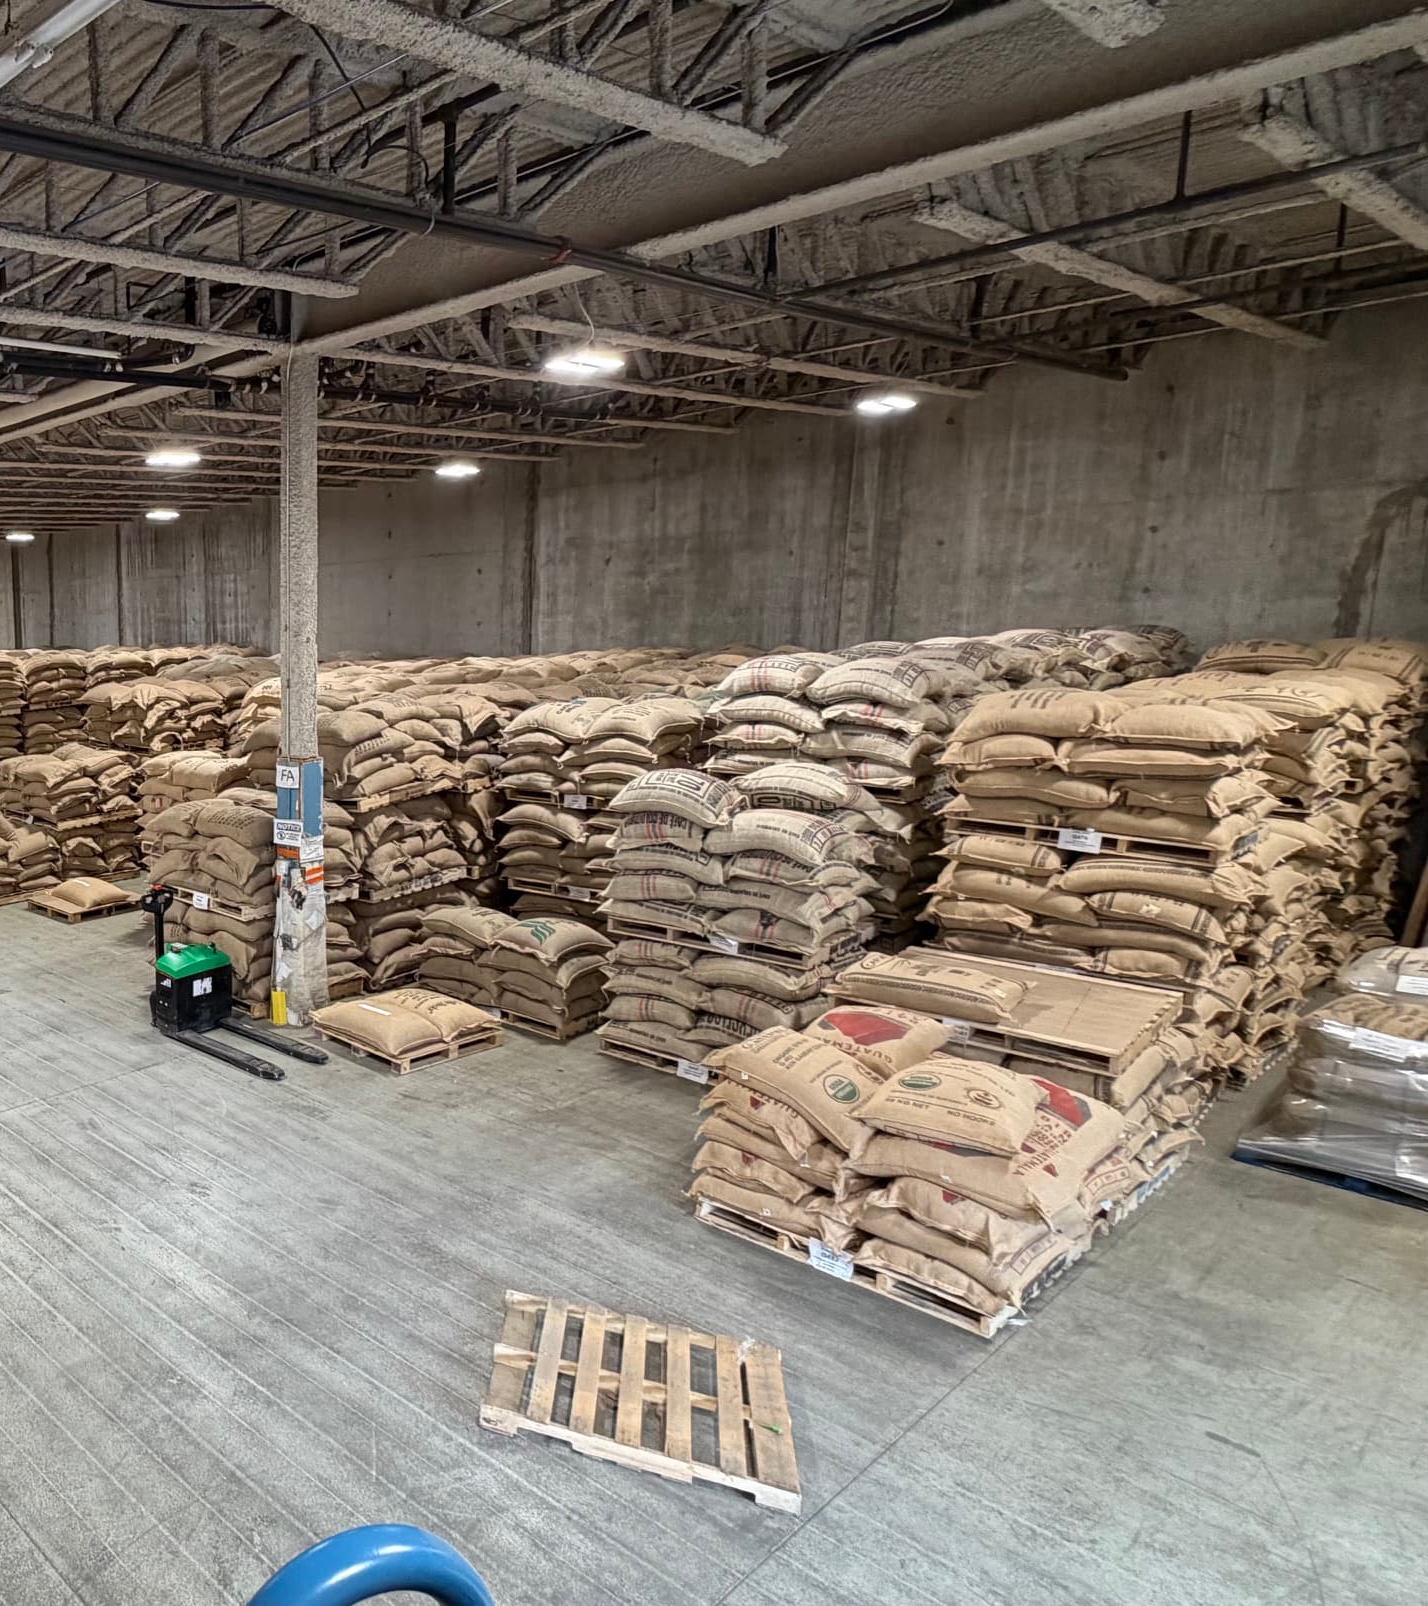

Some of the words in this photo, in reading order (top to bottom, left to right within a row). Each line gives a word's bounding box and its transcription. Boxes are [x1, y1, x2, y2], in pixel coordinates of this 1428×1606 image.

[280, 769, 295, 783] FA
[277, 823, 302, 833] NOTICE
[947, 1110, 962, 1118] NO
